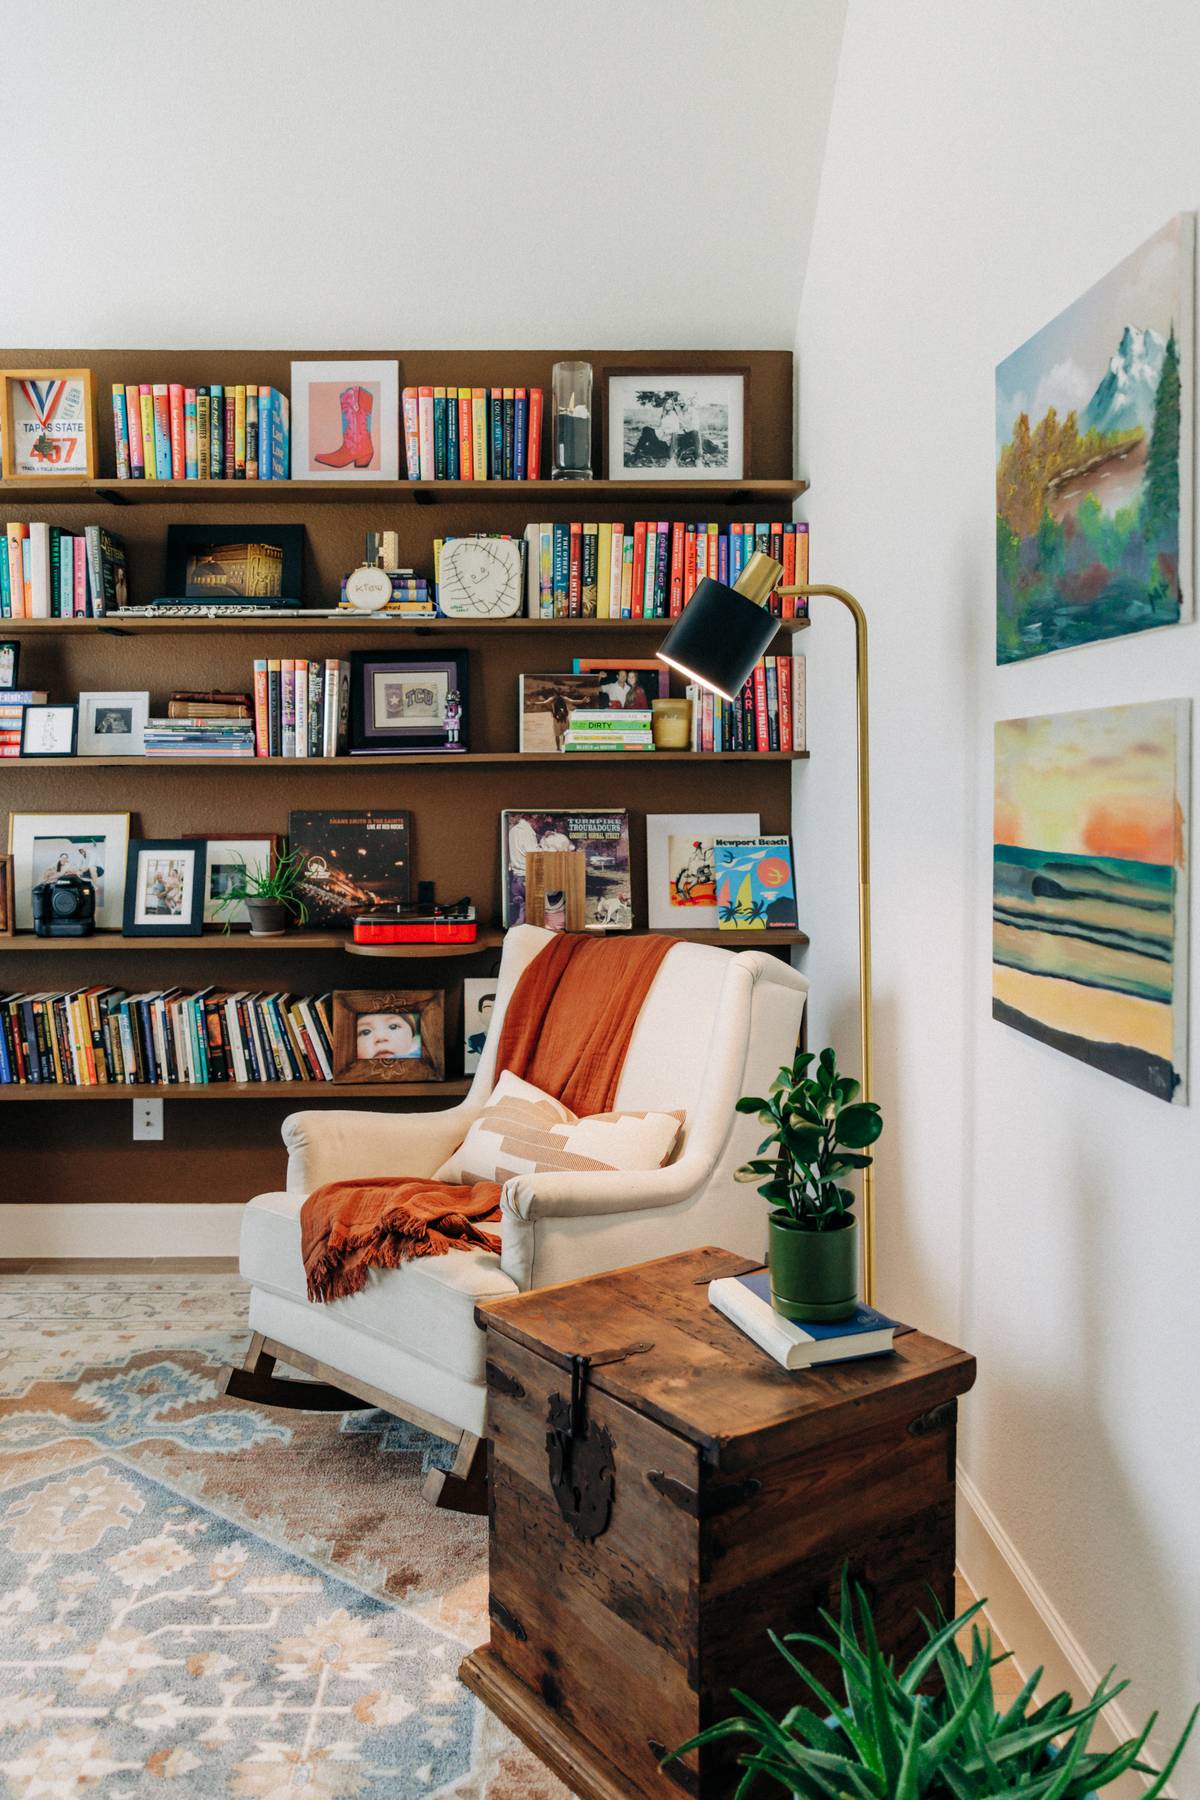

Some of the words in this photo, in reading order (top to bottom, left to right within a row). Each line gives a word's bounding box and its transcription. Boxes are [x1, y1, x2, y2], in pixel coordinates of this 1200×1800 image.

[56, 422, 84, 432] STATE
[30, 437, 78, 464] 457
[688, 552, 696, 574] MAID
[406, 688, 433, 707] TCU
[716, 839, 756, 847] Newport
